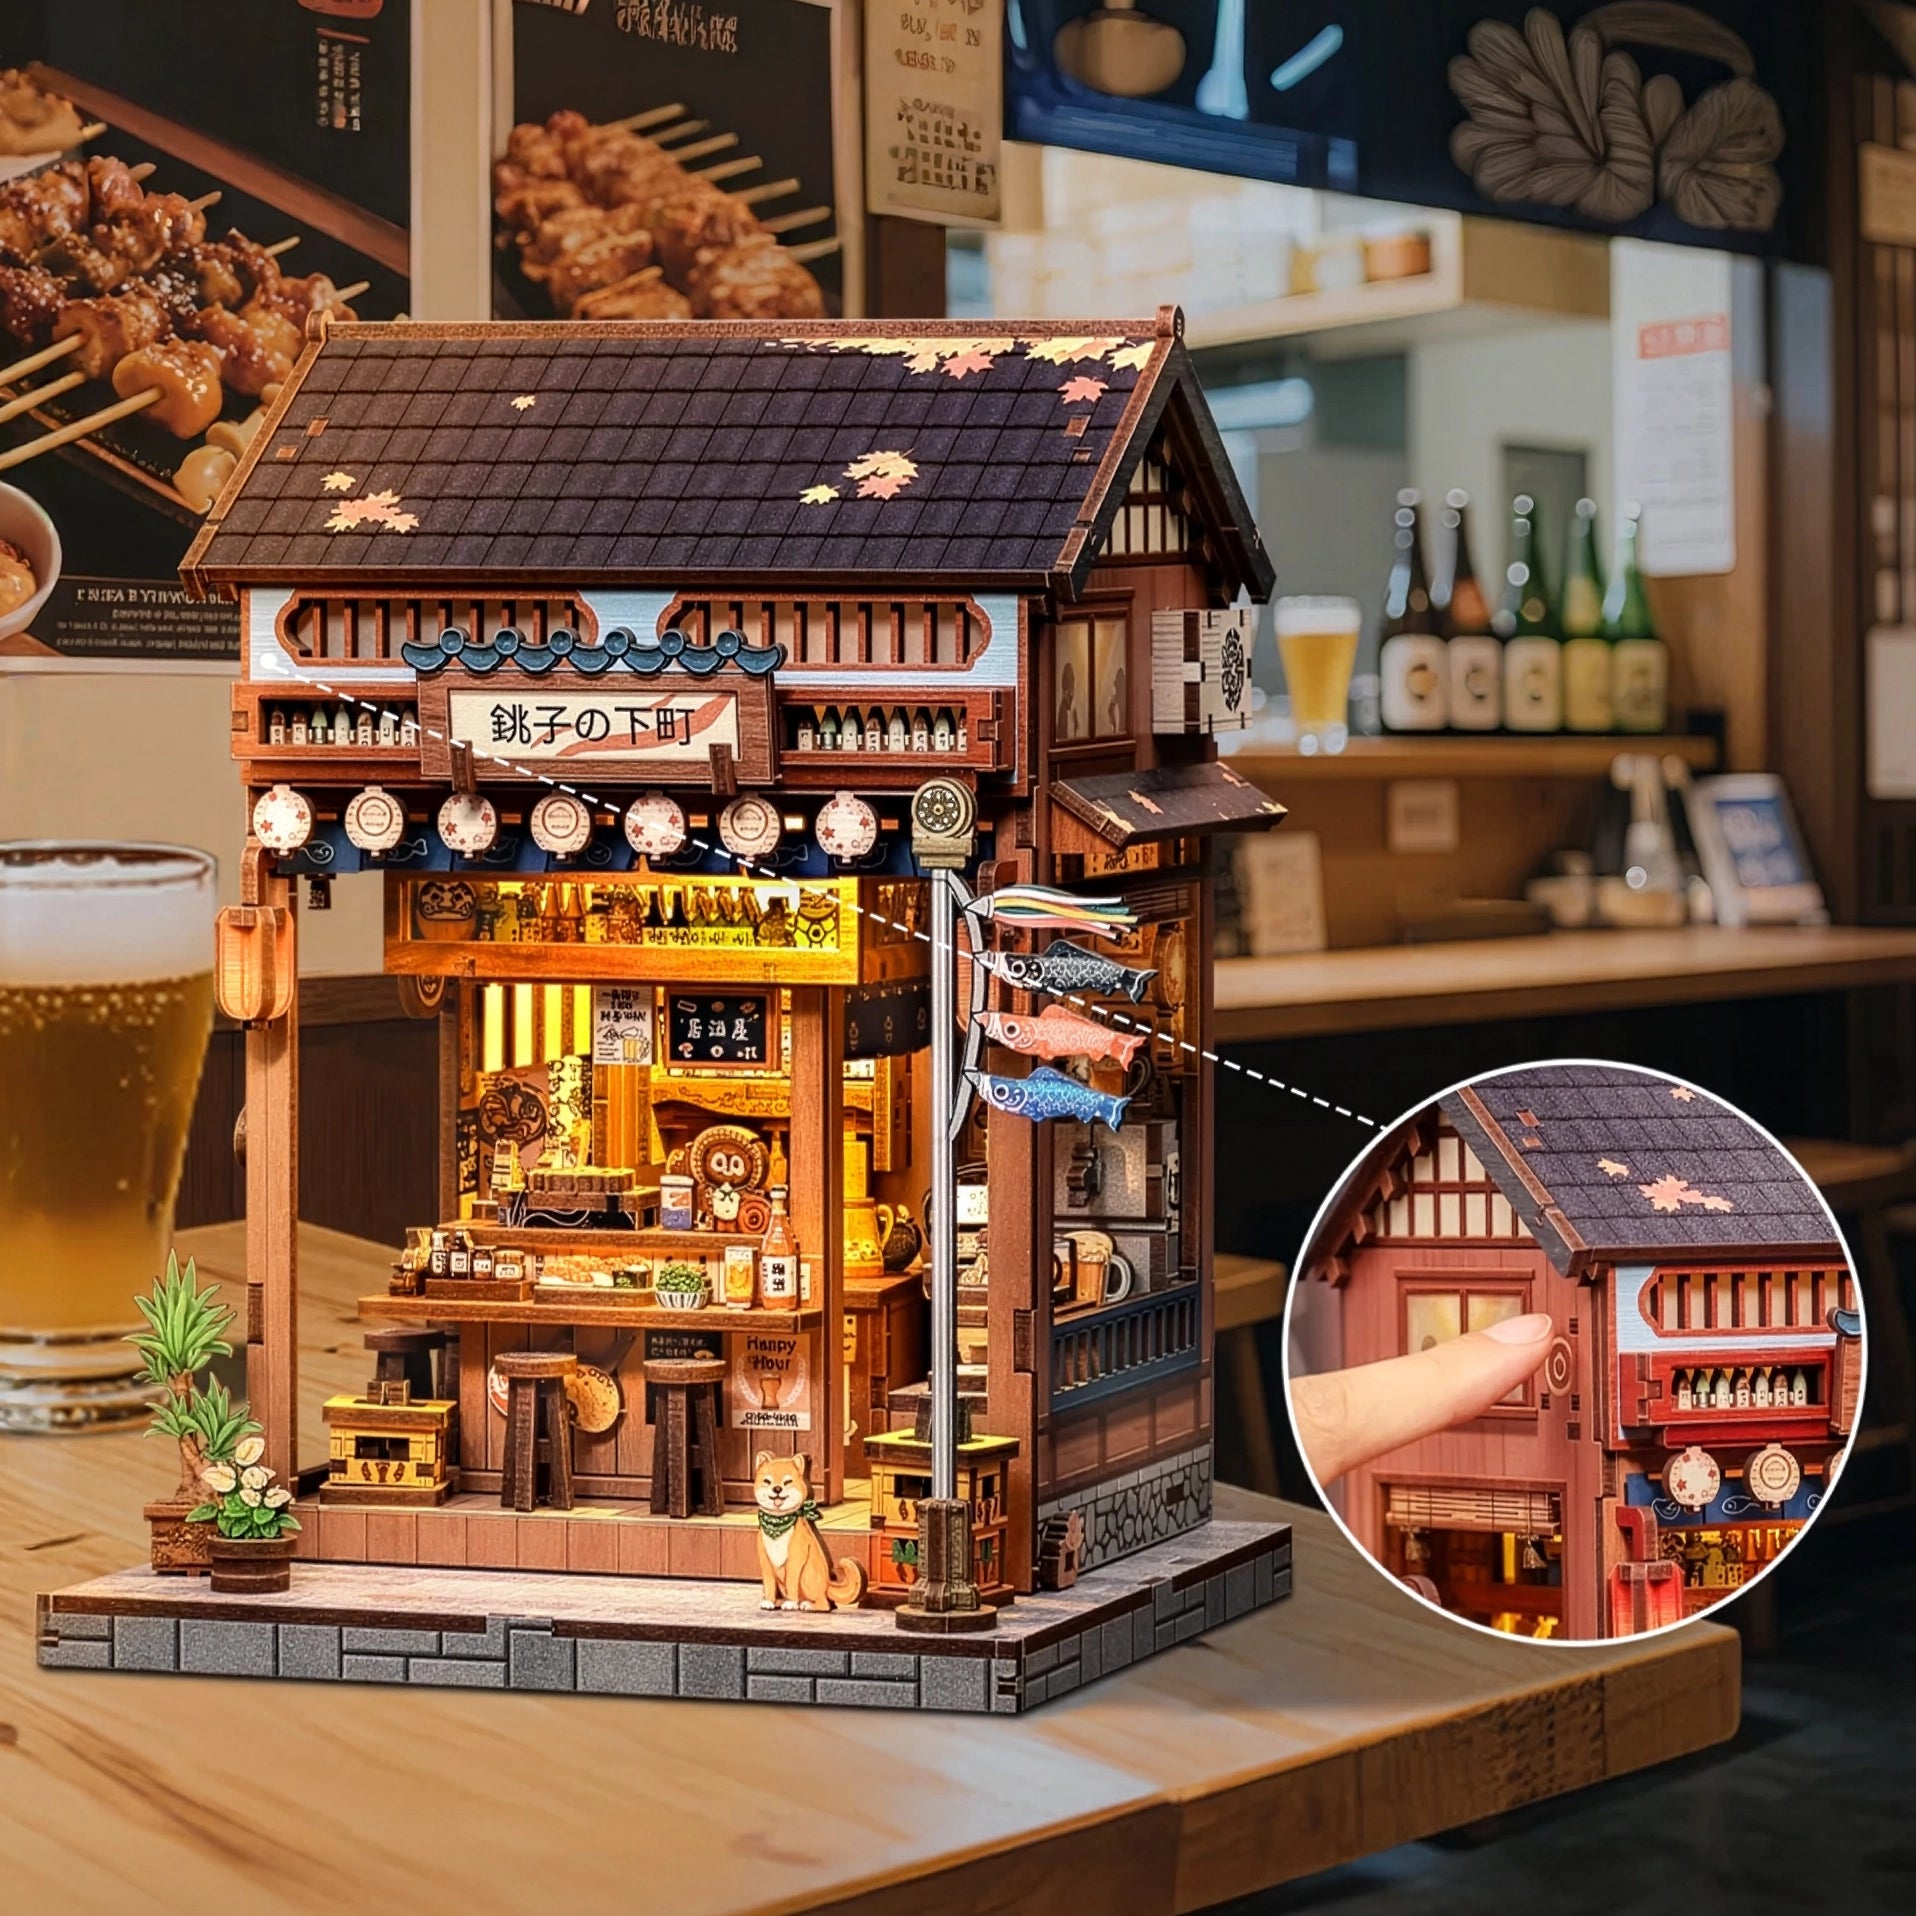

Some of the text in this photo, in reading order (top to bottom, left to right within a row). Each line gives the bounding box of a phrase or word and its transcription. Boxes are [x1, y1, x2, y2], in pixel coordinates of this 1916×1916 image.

[489, 702, 696, 746] 銚子の下町
